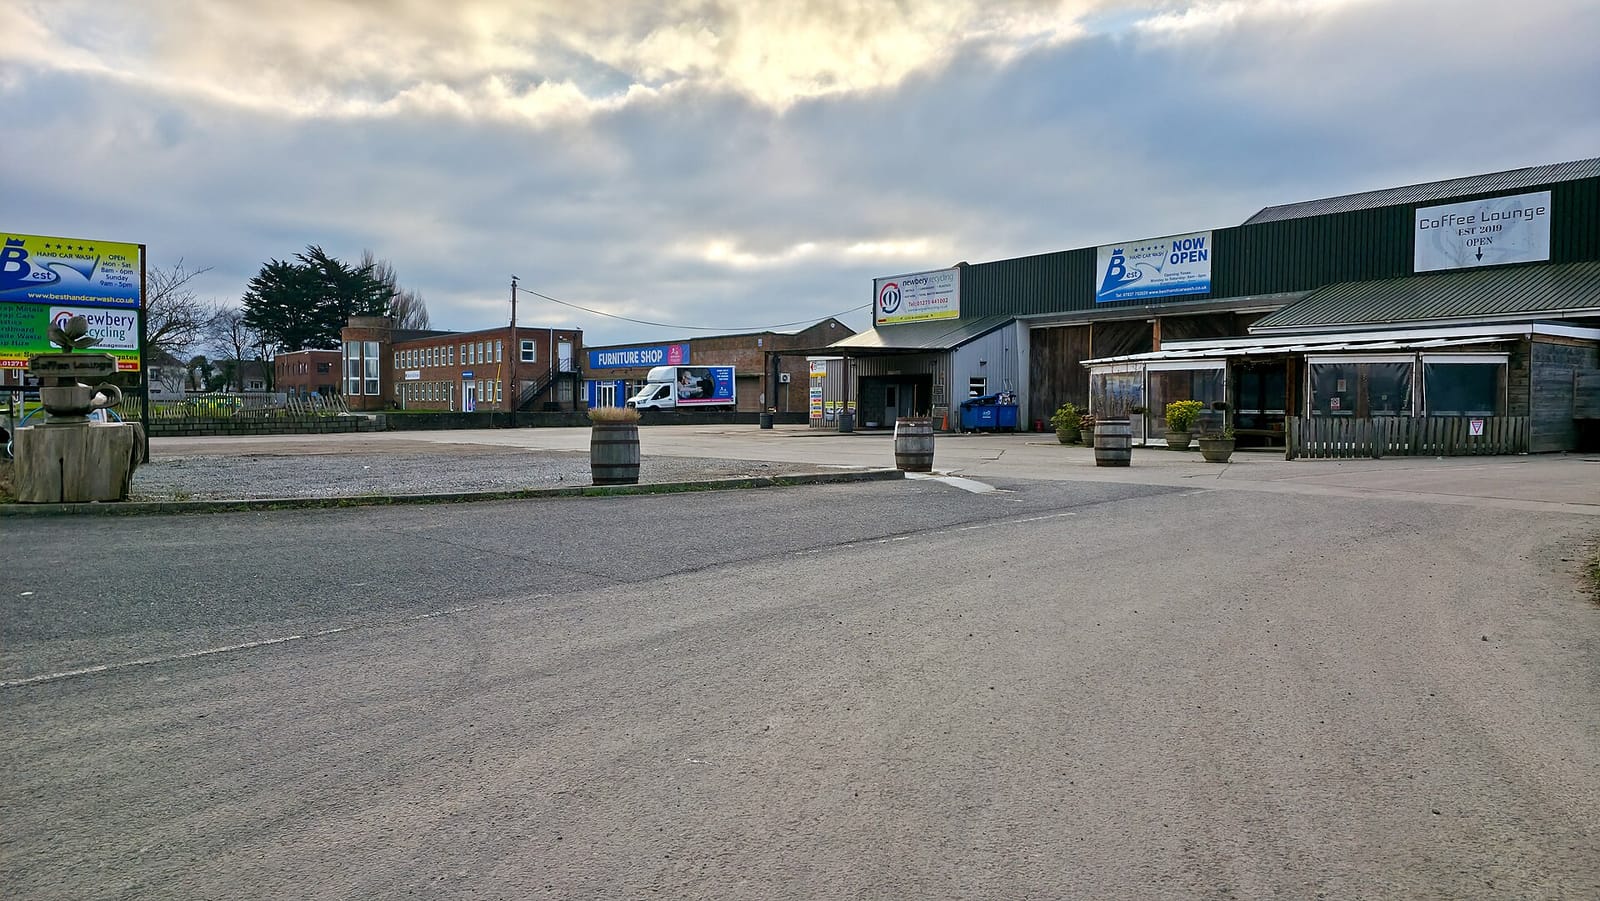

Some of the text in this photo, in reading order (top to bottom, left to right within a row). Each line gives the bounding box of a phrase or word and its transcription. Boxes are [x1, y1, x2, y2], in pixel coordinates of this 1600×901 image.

[1419, 206, 1545, 230] Coffee Lounge
[1458, 224, 1502, 236] EST 2019
[1172, 237, 1206, 253] NOW
[1466, 237, 1493, 247] OPEN
[1170, 249, 1208, 265] OPEN
[120, 268, 134, 276] 6pm
[105, 274, 129, 282] Sunday
[903, 278, 928, 286] newbery
[119, 281, 133, 289] 5pm
[28, 293, 134, 303] www.besthandcarwash.co.uk
[85, 327, 125, 340] cycling
[598, 352, 639, 366] FURNITURE
[640, 349, 663, 363] SHOP
